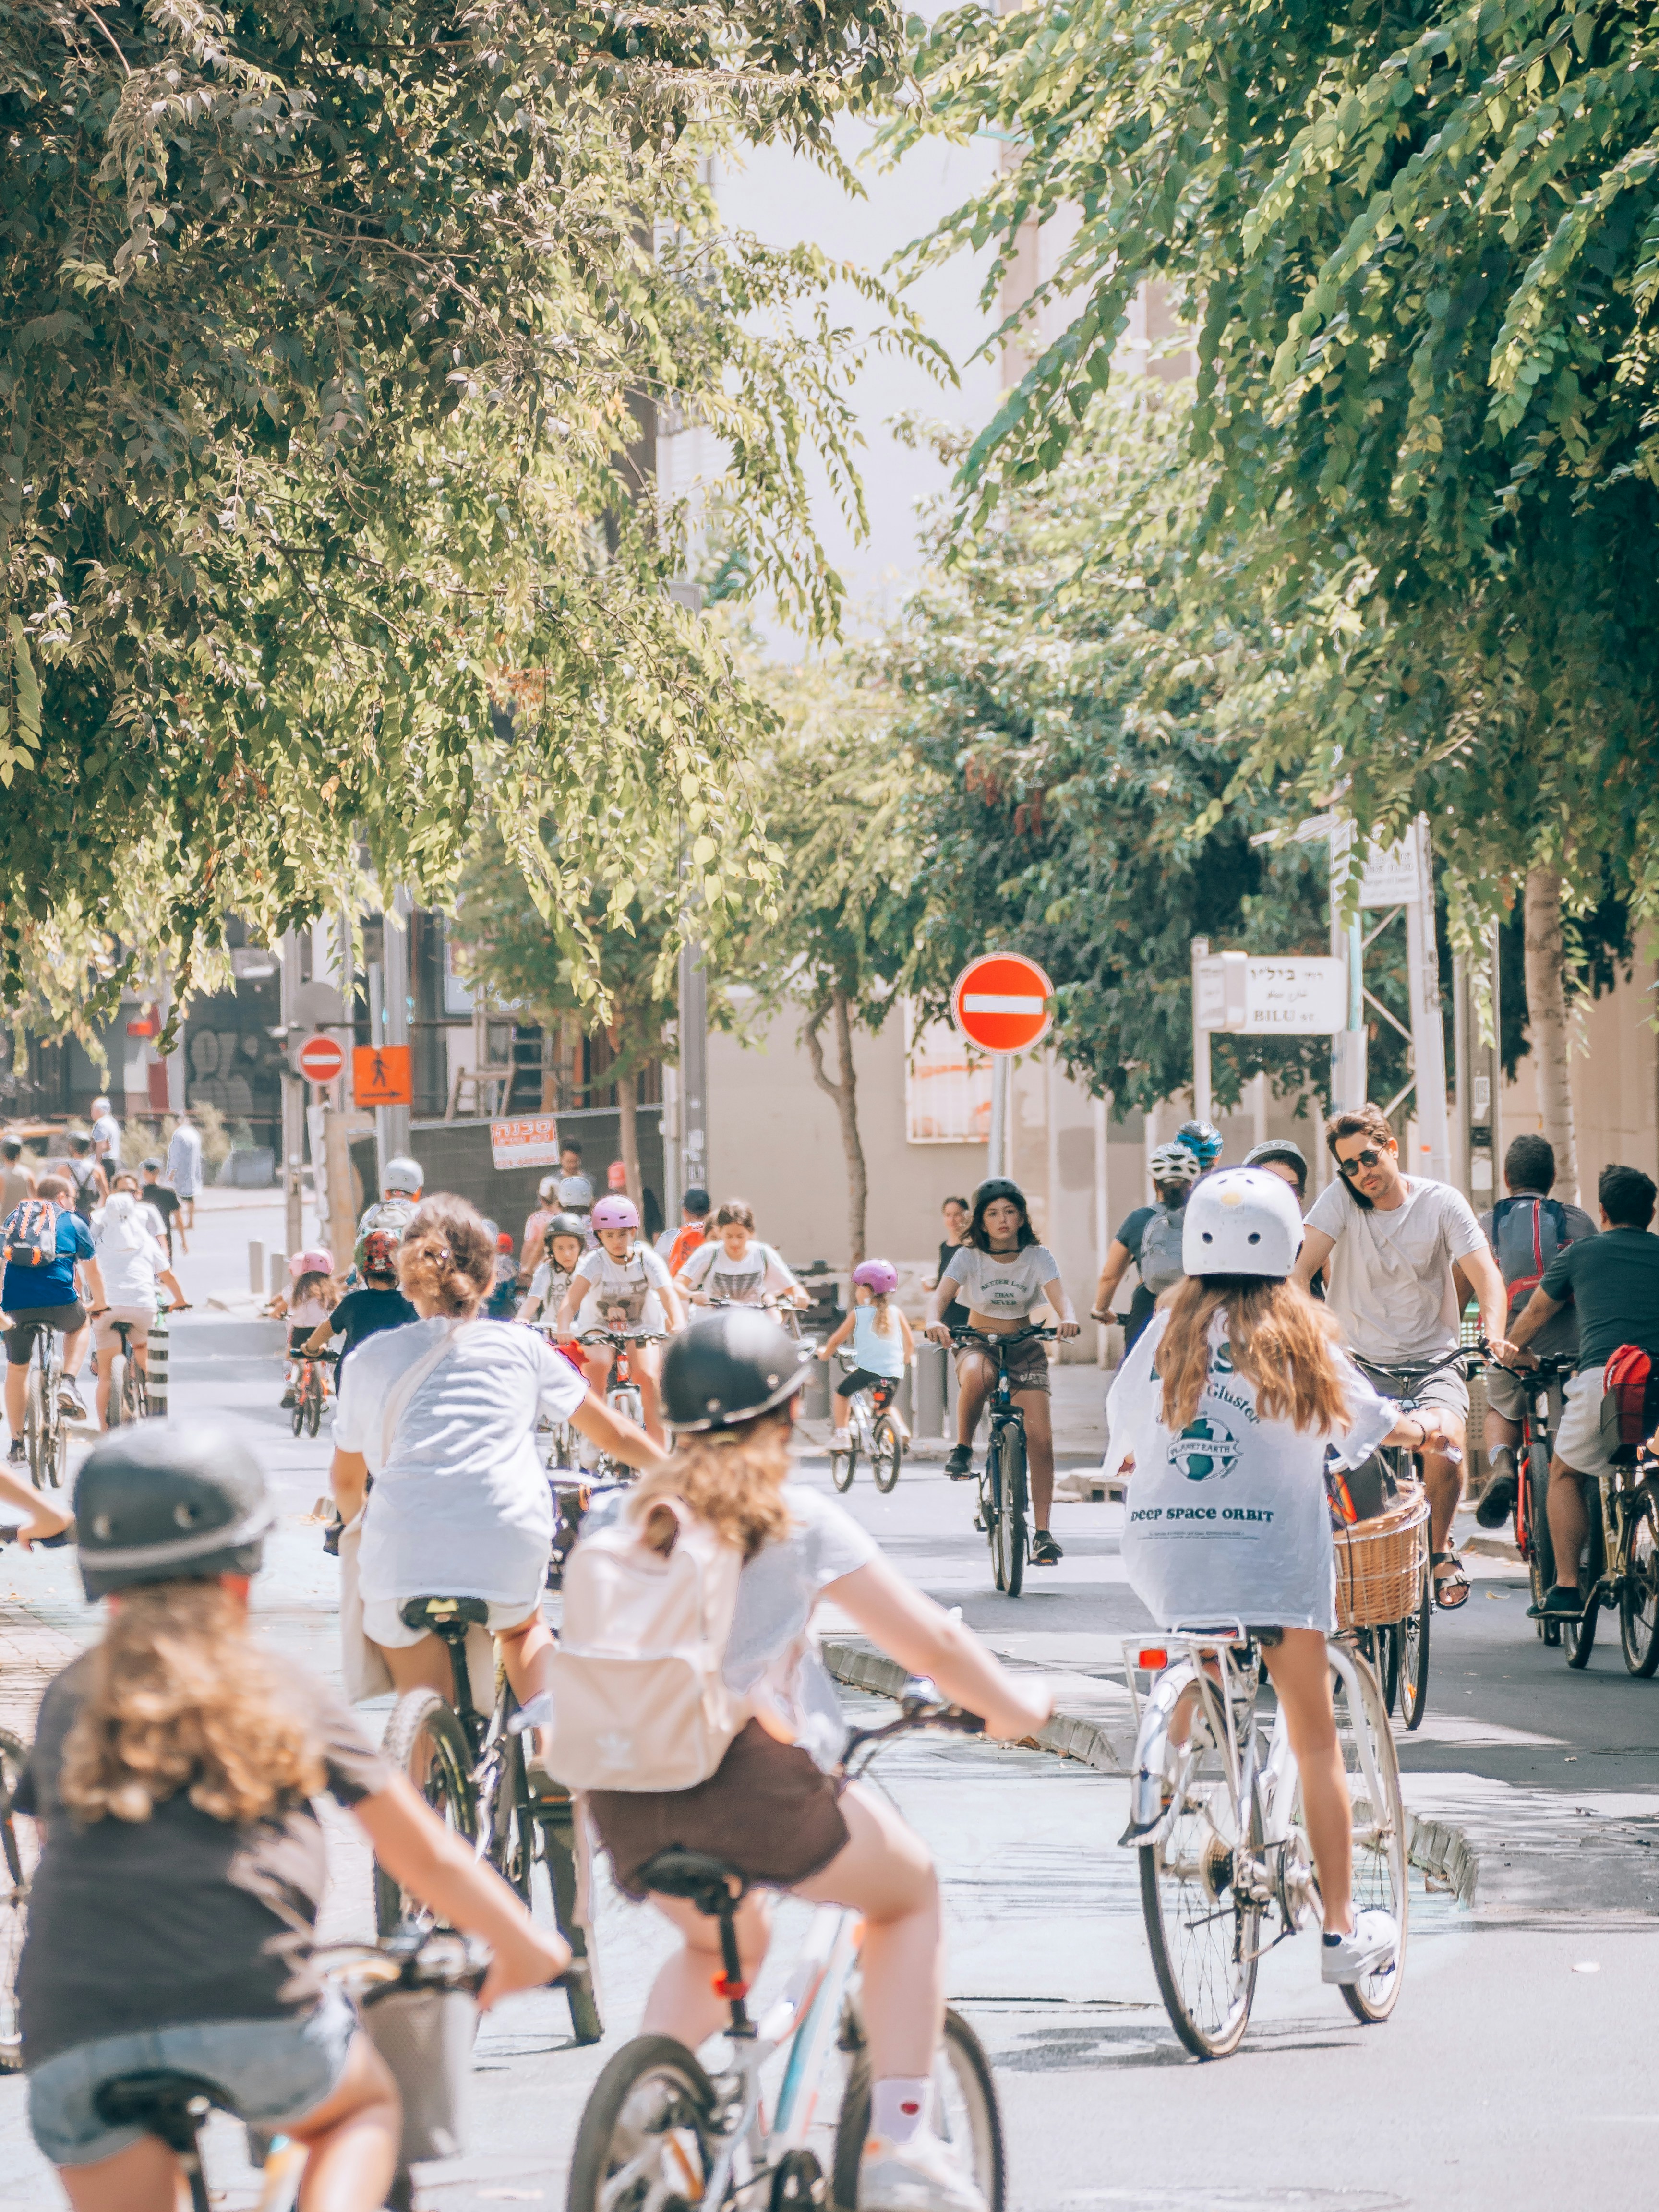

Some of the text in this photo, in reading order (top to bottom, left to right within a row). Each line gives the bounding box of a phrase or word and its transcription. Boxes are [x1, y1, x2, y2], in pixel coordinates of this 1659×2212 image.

[1254, 1010, 1295, 1022] BILU
[496, 1121, 550, 1137] סכנה
[980, 1279, 1009, 1291] BETTER
[1222, 1508, 1274, 1523] ORBIT
